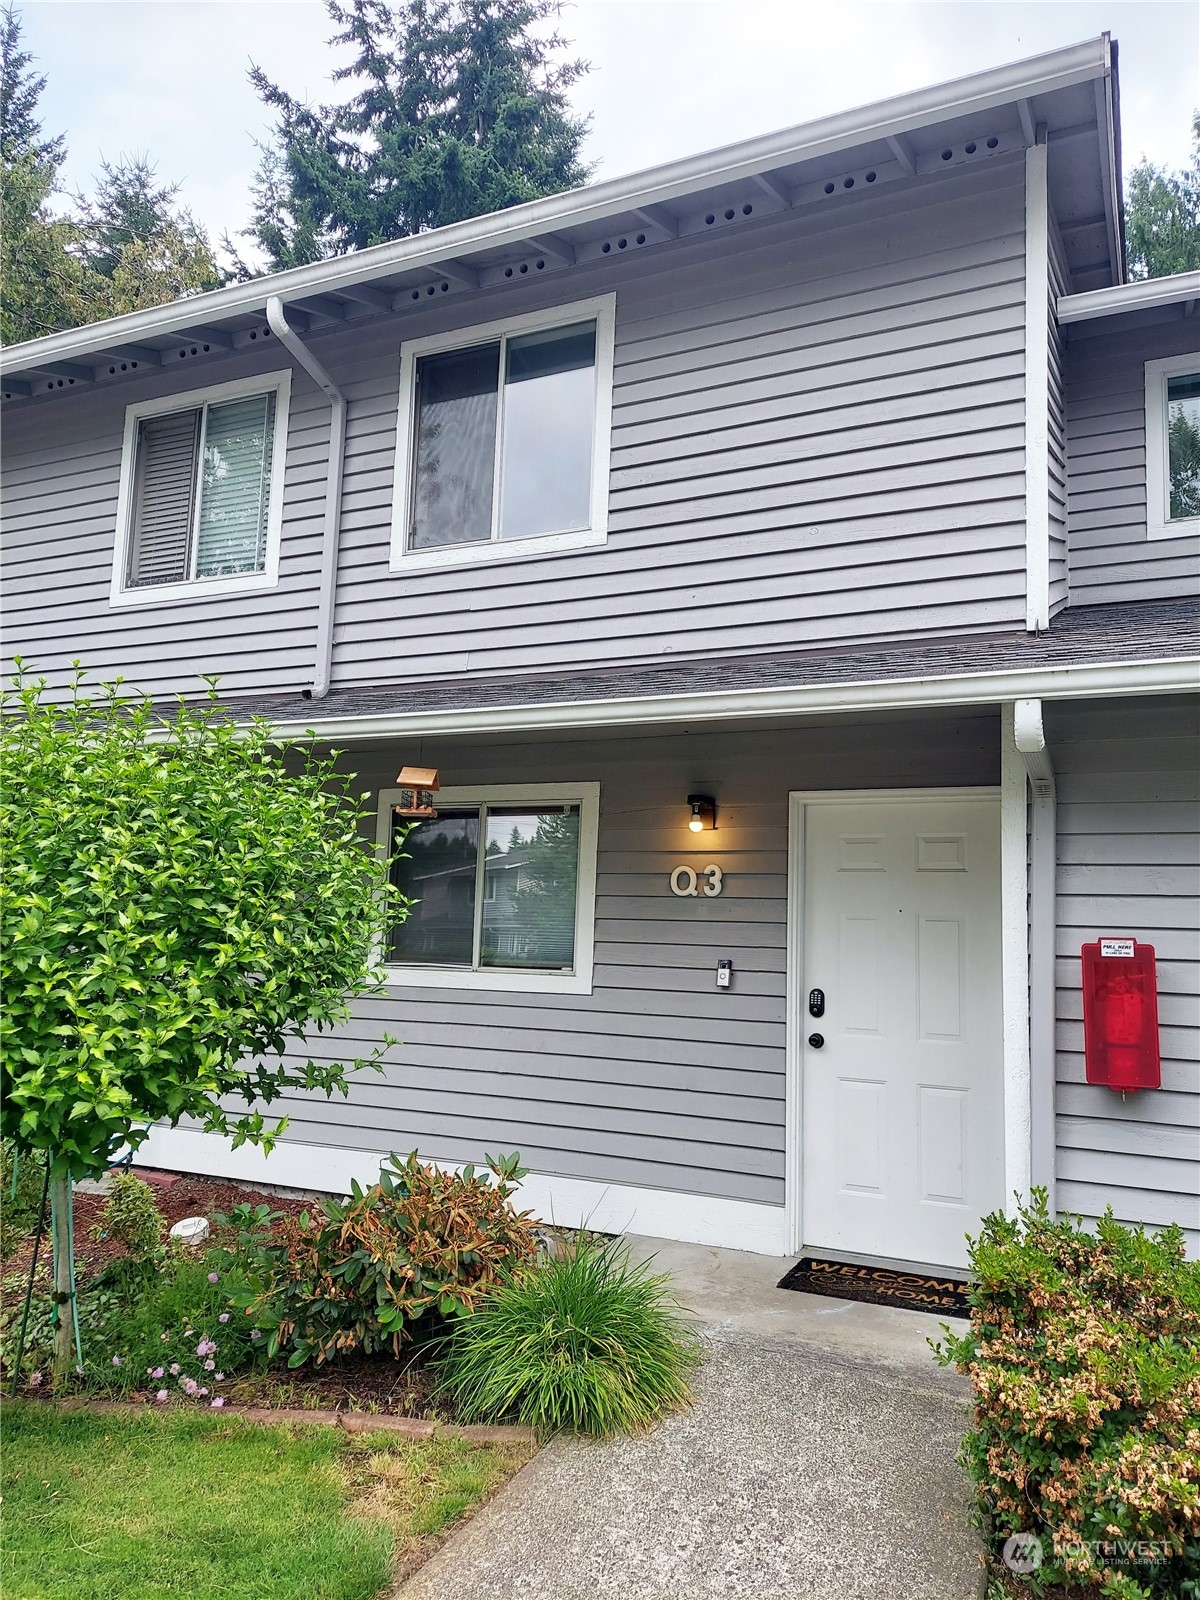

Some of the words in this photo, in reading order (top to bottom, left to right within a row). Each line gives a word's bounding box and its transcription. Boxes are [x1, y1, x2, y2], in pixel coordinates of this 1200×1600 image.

[669, 864, 723, 897] Q3
[811, 1261, 972, 1295] WELCOME
[876, 1286, 956, 1305] HOME
